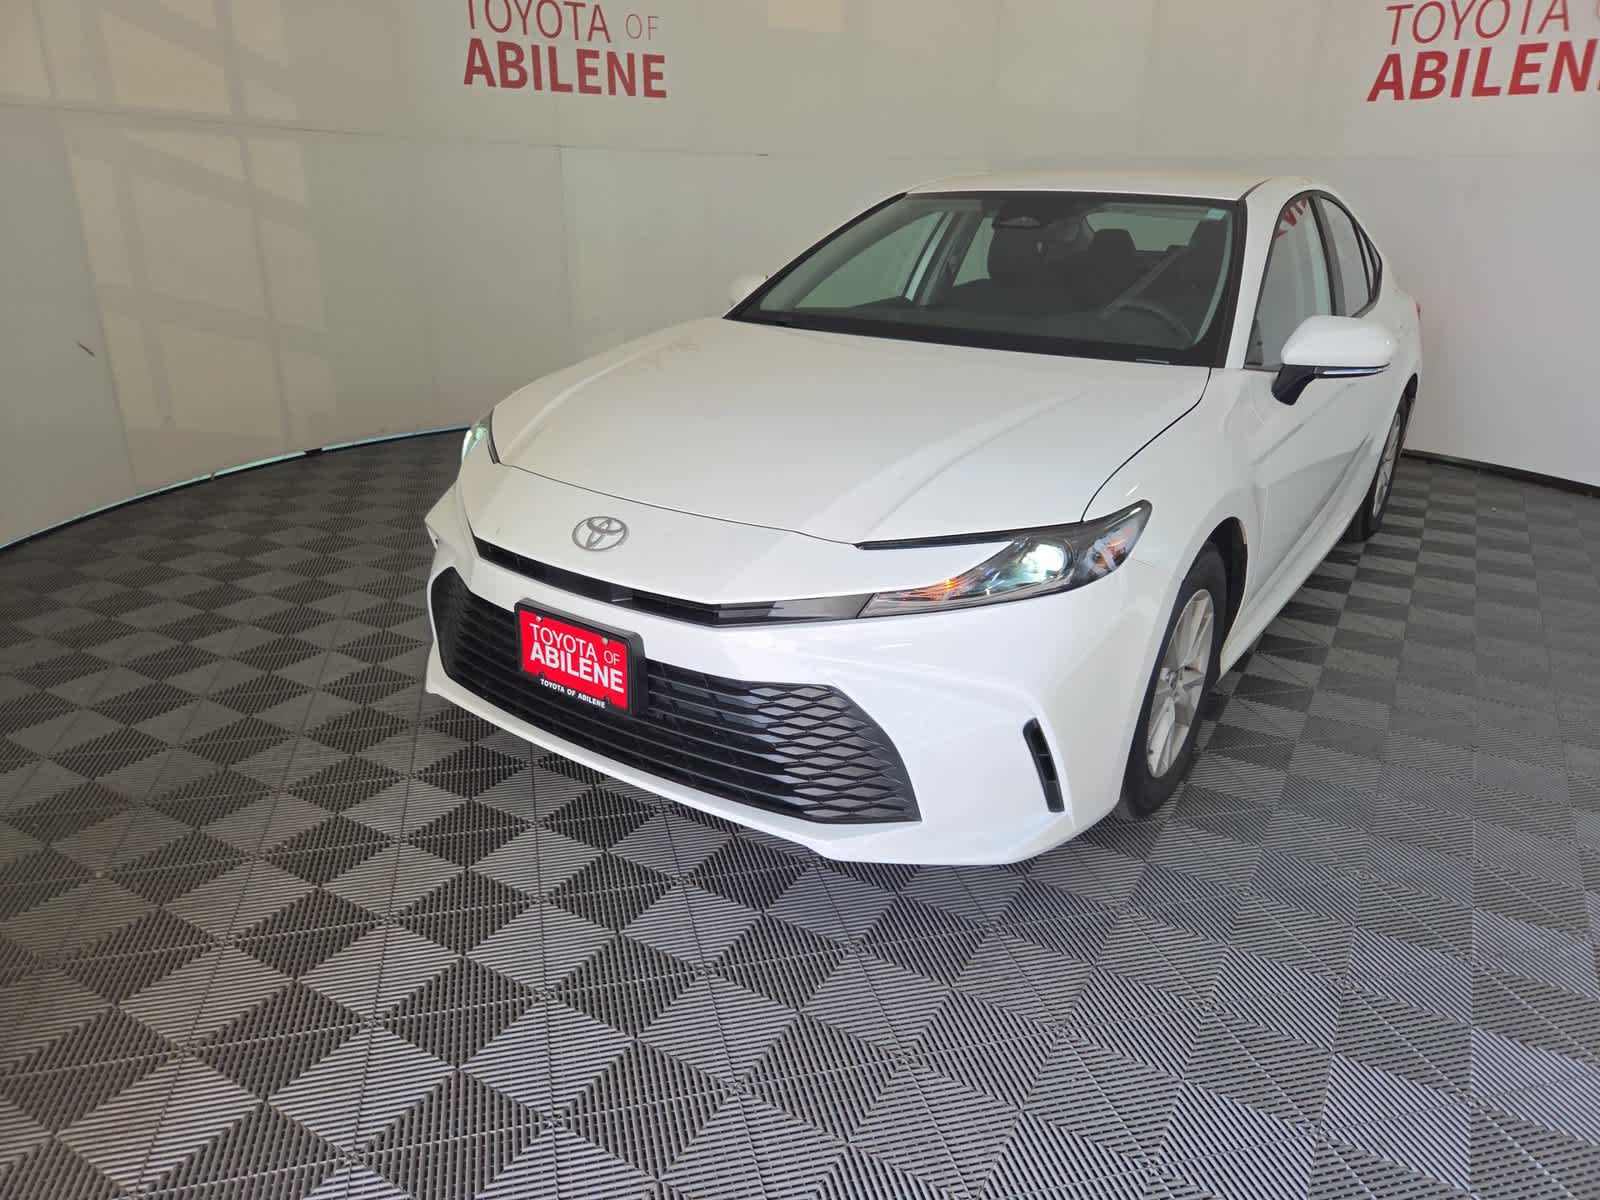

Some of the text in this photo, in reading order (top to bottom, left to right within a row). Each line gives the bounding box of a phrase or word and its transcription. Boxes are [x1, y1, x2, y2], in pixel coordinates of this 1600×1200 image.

[625, 13, 660, 41] OF
[463, 38, 668, 99] ABILENE
[1366, 38, 1600, 102] ABILEN
[529, 622, 621, 665] TOYOTA OF
[530, 641, 625, 693] ABILENE
[540, 678, 606, 709] TOYOTA OF ABILENE
